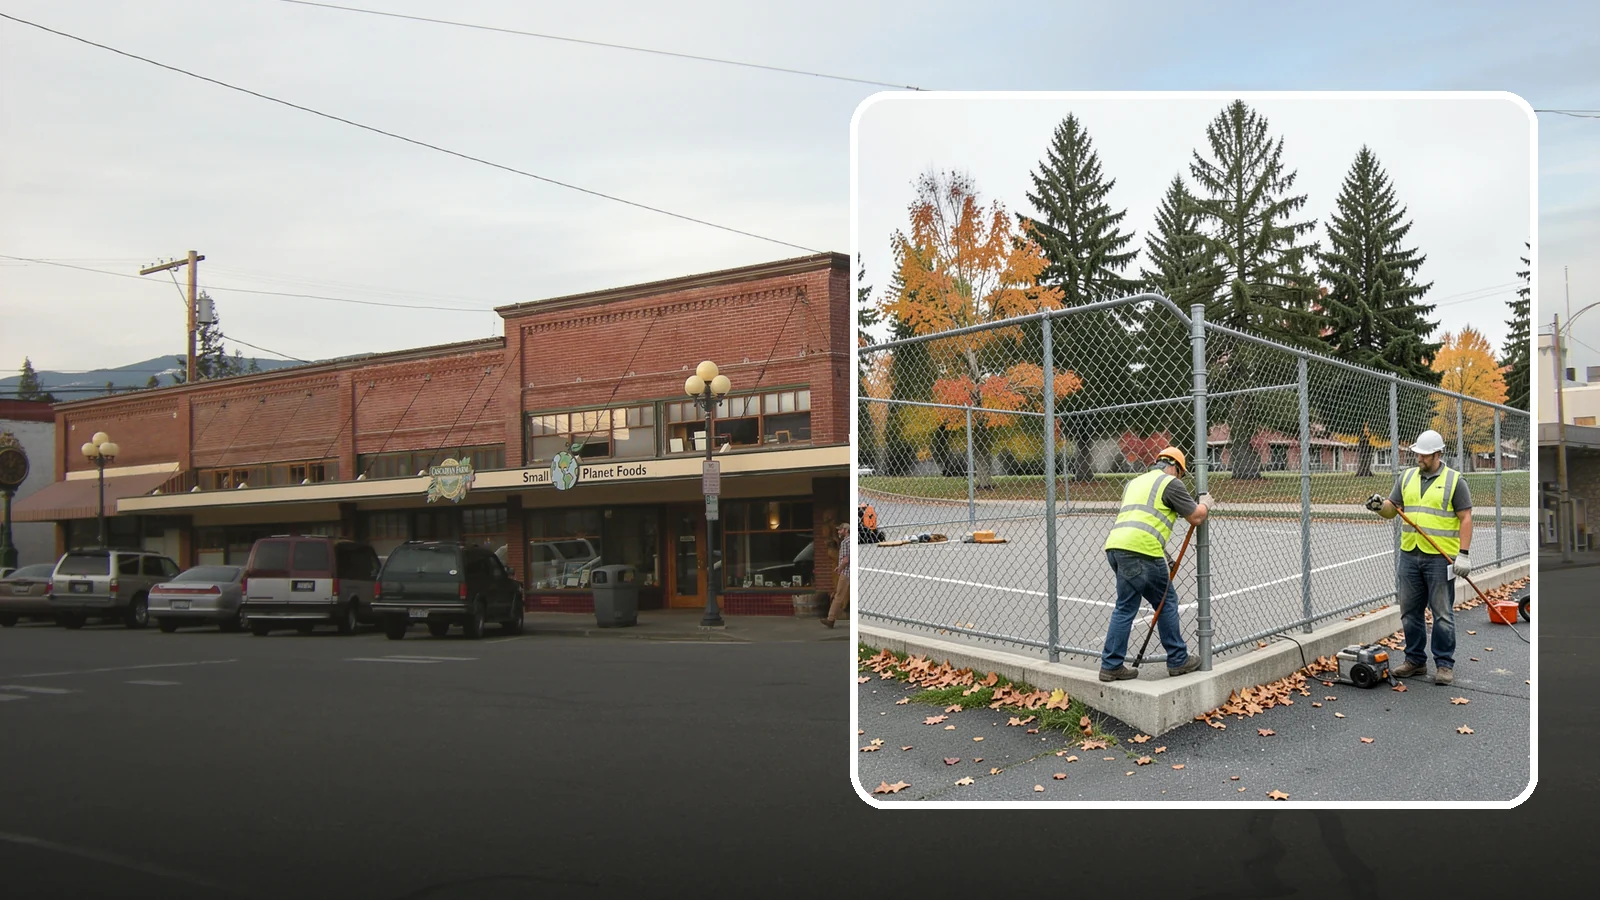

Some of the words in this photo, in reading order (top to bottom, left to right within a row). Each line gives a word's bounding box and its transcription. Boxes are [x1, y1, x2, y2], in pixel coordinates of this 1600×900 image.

[523, 471, 548, 483] Small
[583, 466, 614, 479] Planet
[616, 465, 647, 477] Foods
